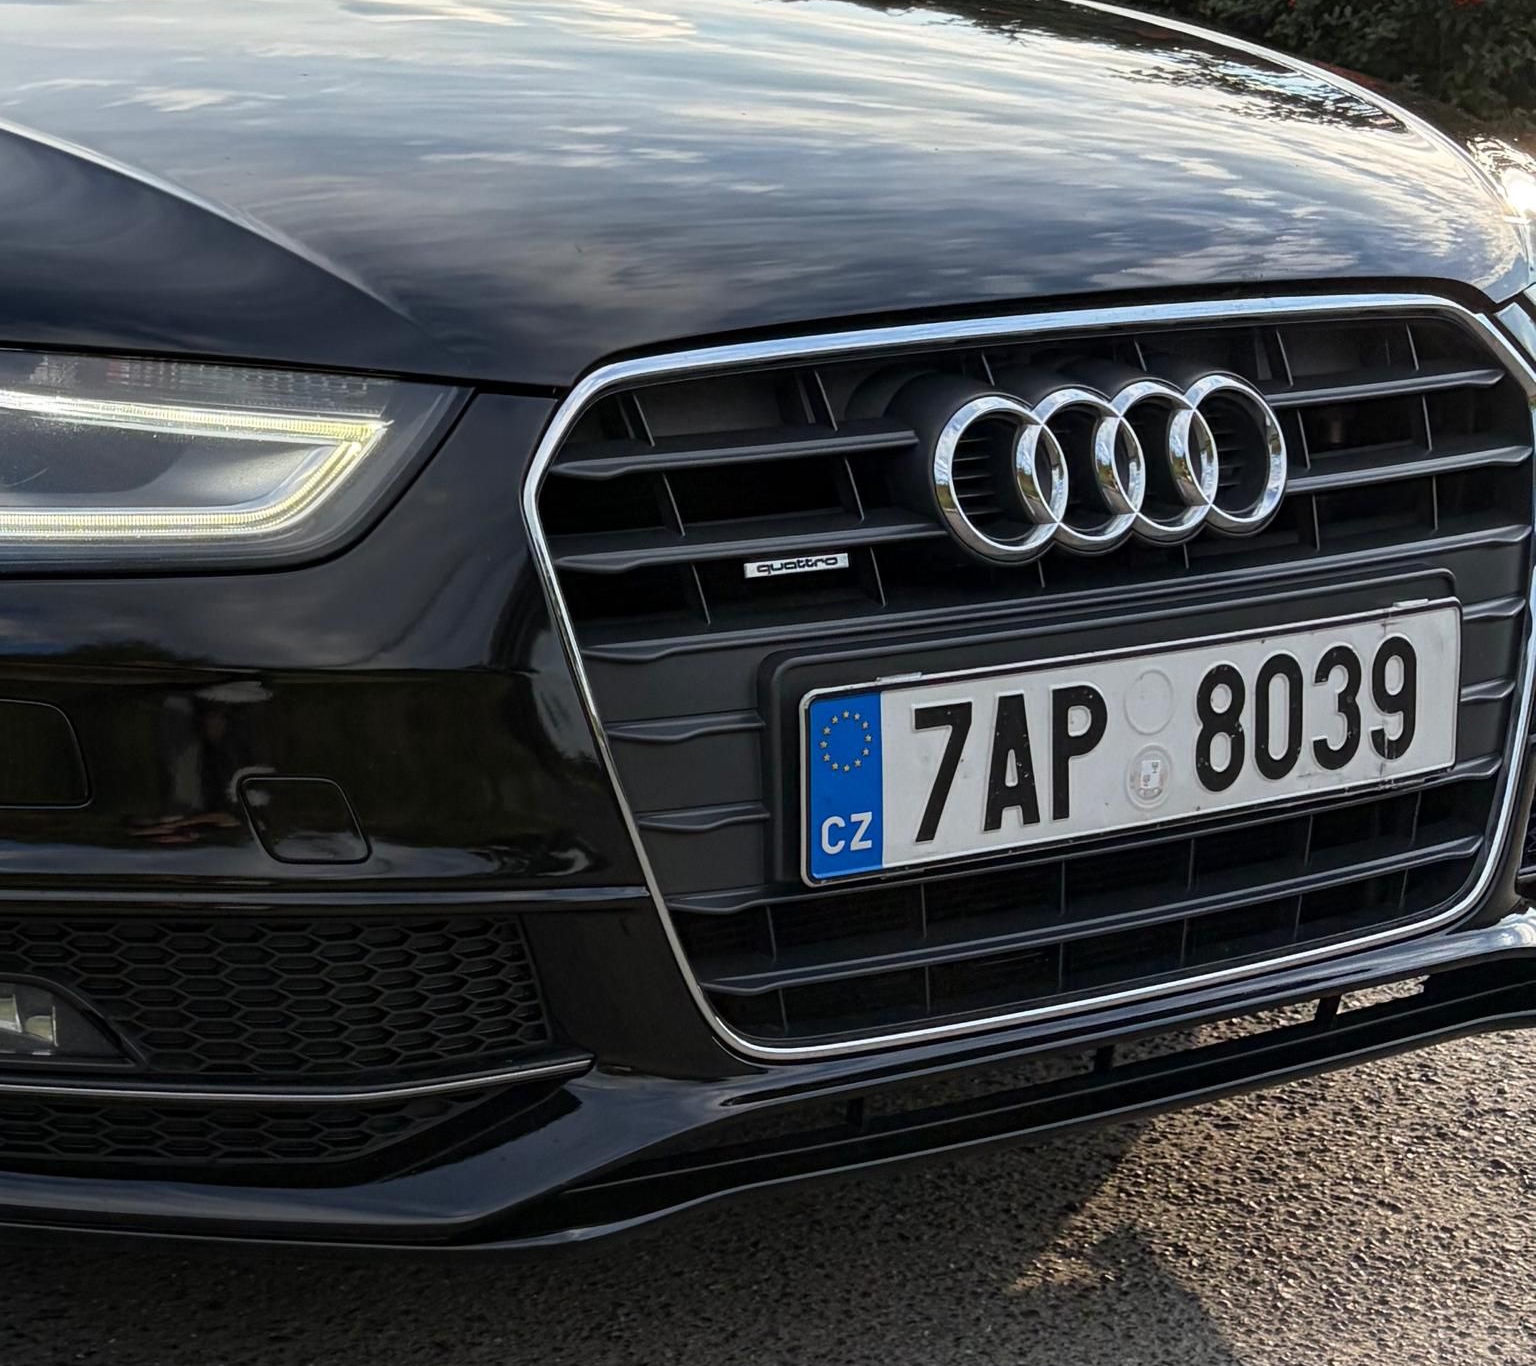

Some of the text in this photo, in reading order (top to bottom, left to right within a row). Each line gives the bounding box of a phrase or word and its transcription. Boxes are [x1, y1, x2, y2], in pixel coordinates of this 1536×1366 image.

[756, 556, 839, 575] quattro
[914, 635, 1418, 844] 7AP 8039
[820, 811, 874, 856] CZ
